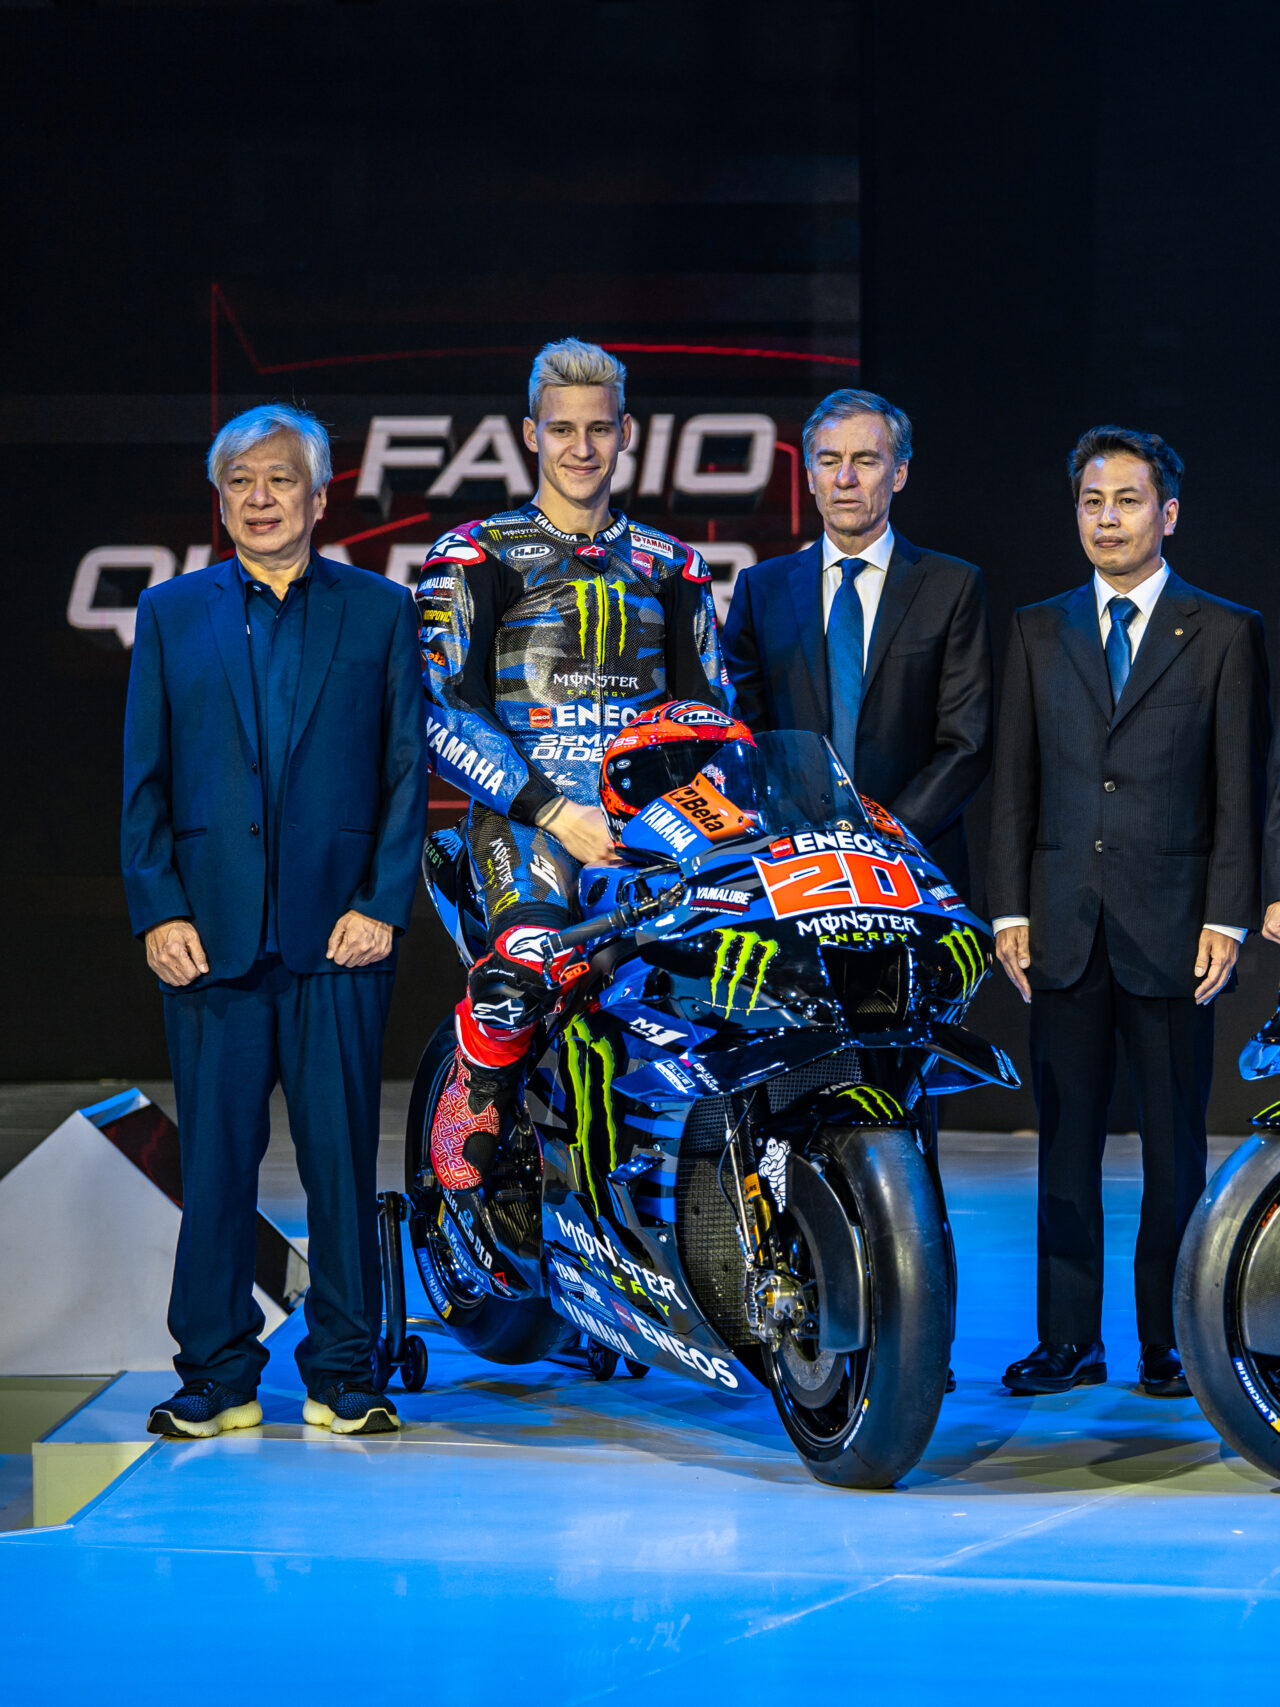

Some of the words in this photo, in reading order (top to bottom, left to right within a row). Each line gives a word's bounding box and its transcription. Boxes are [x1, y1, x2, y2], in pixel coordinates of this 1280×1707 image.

[502, 528, 540, 537] MONSTER
[535, 513, 578, 542] YAMAHA
[514, 545, 546, 557] HJC
[641, 536, 672, 553] YAMAHA
[553, 673, 639, 690] MONSTER
[566, 689, 627, 698] ENERGY
[556, 703, 640, 727] ENEO
[682, 711, 730, 724] HJC
[426, 716, 505, 796] YAMAHA
[680, 792, 724, 832] Beta
[641, 802, 698, 853] YAMAHA
[793, 831, 888, 857] ENEOS
[695, 886, 751, 905] YAMALUBE
[752, 850, 923, 920] 20
[796, 911, 922, 936] MONSTER
[819, 931, 908, 944] ENERGY
[449, 1232, 485, 1284] MICHELIN
[420, 1252, 444, 1305] MICHELIN
[560, 1296, 639, 1360] YAMAHA
[631, 1312, 739, 1389] ENEOS
[1235, 1361, 1270, 1413] MICHELIN
